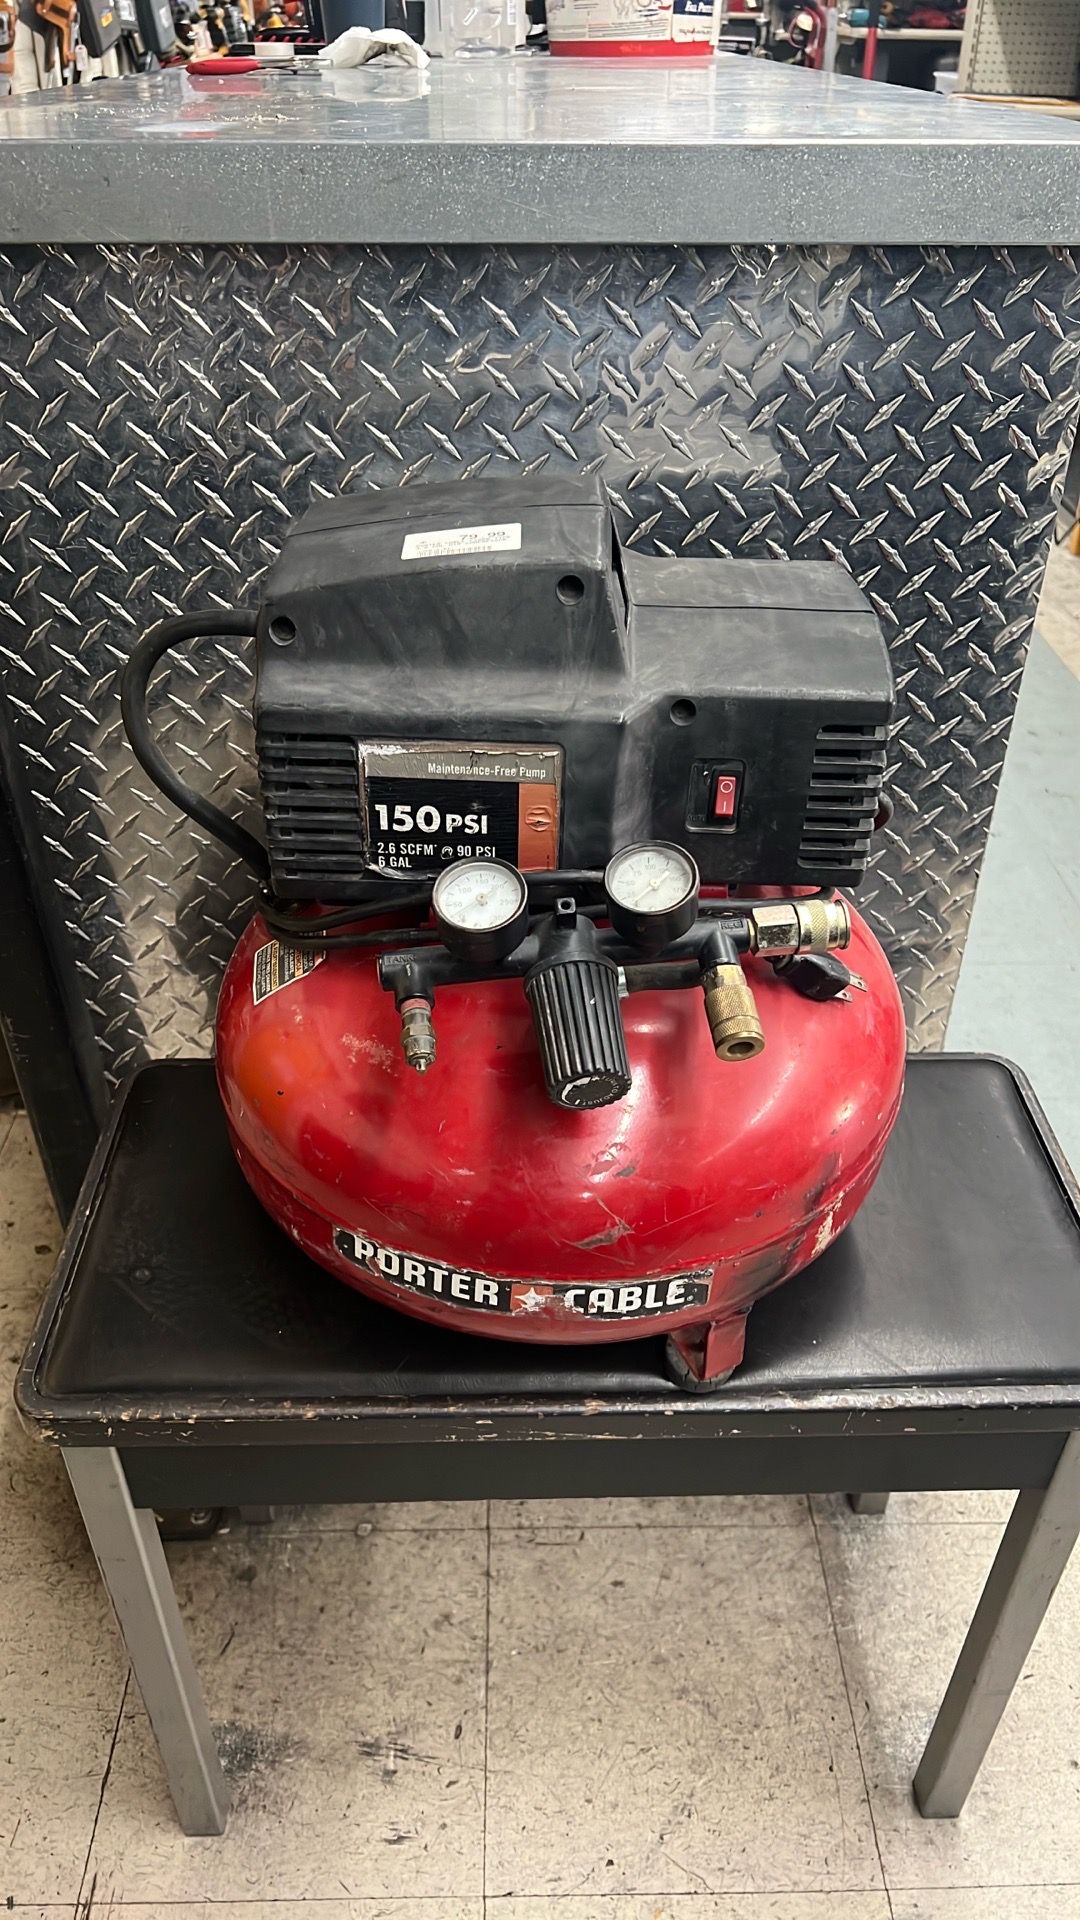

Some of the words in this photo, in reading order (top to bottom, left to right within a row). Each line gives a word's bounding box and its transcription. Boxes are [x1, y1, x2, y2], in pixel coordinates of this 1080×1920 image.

[428, 763, 517, 777] Maintenance-Free
[519, 767, 547, 778] Pump
[375, 804, 441, 833] 150
[445, 813, 488, 835] PSI
[377, 842, 396, 855] 2.6
[457, 845, 472, 857] 90
[476, 846, 496, 858] PSI
[378, 855, 386, 867] 6
[389, 856, 412, 868] GAL
[352, 1235, 499, 1307] PORTER
[563, 1278, 687, 1314] CABLE
